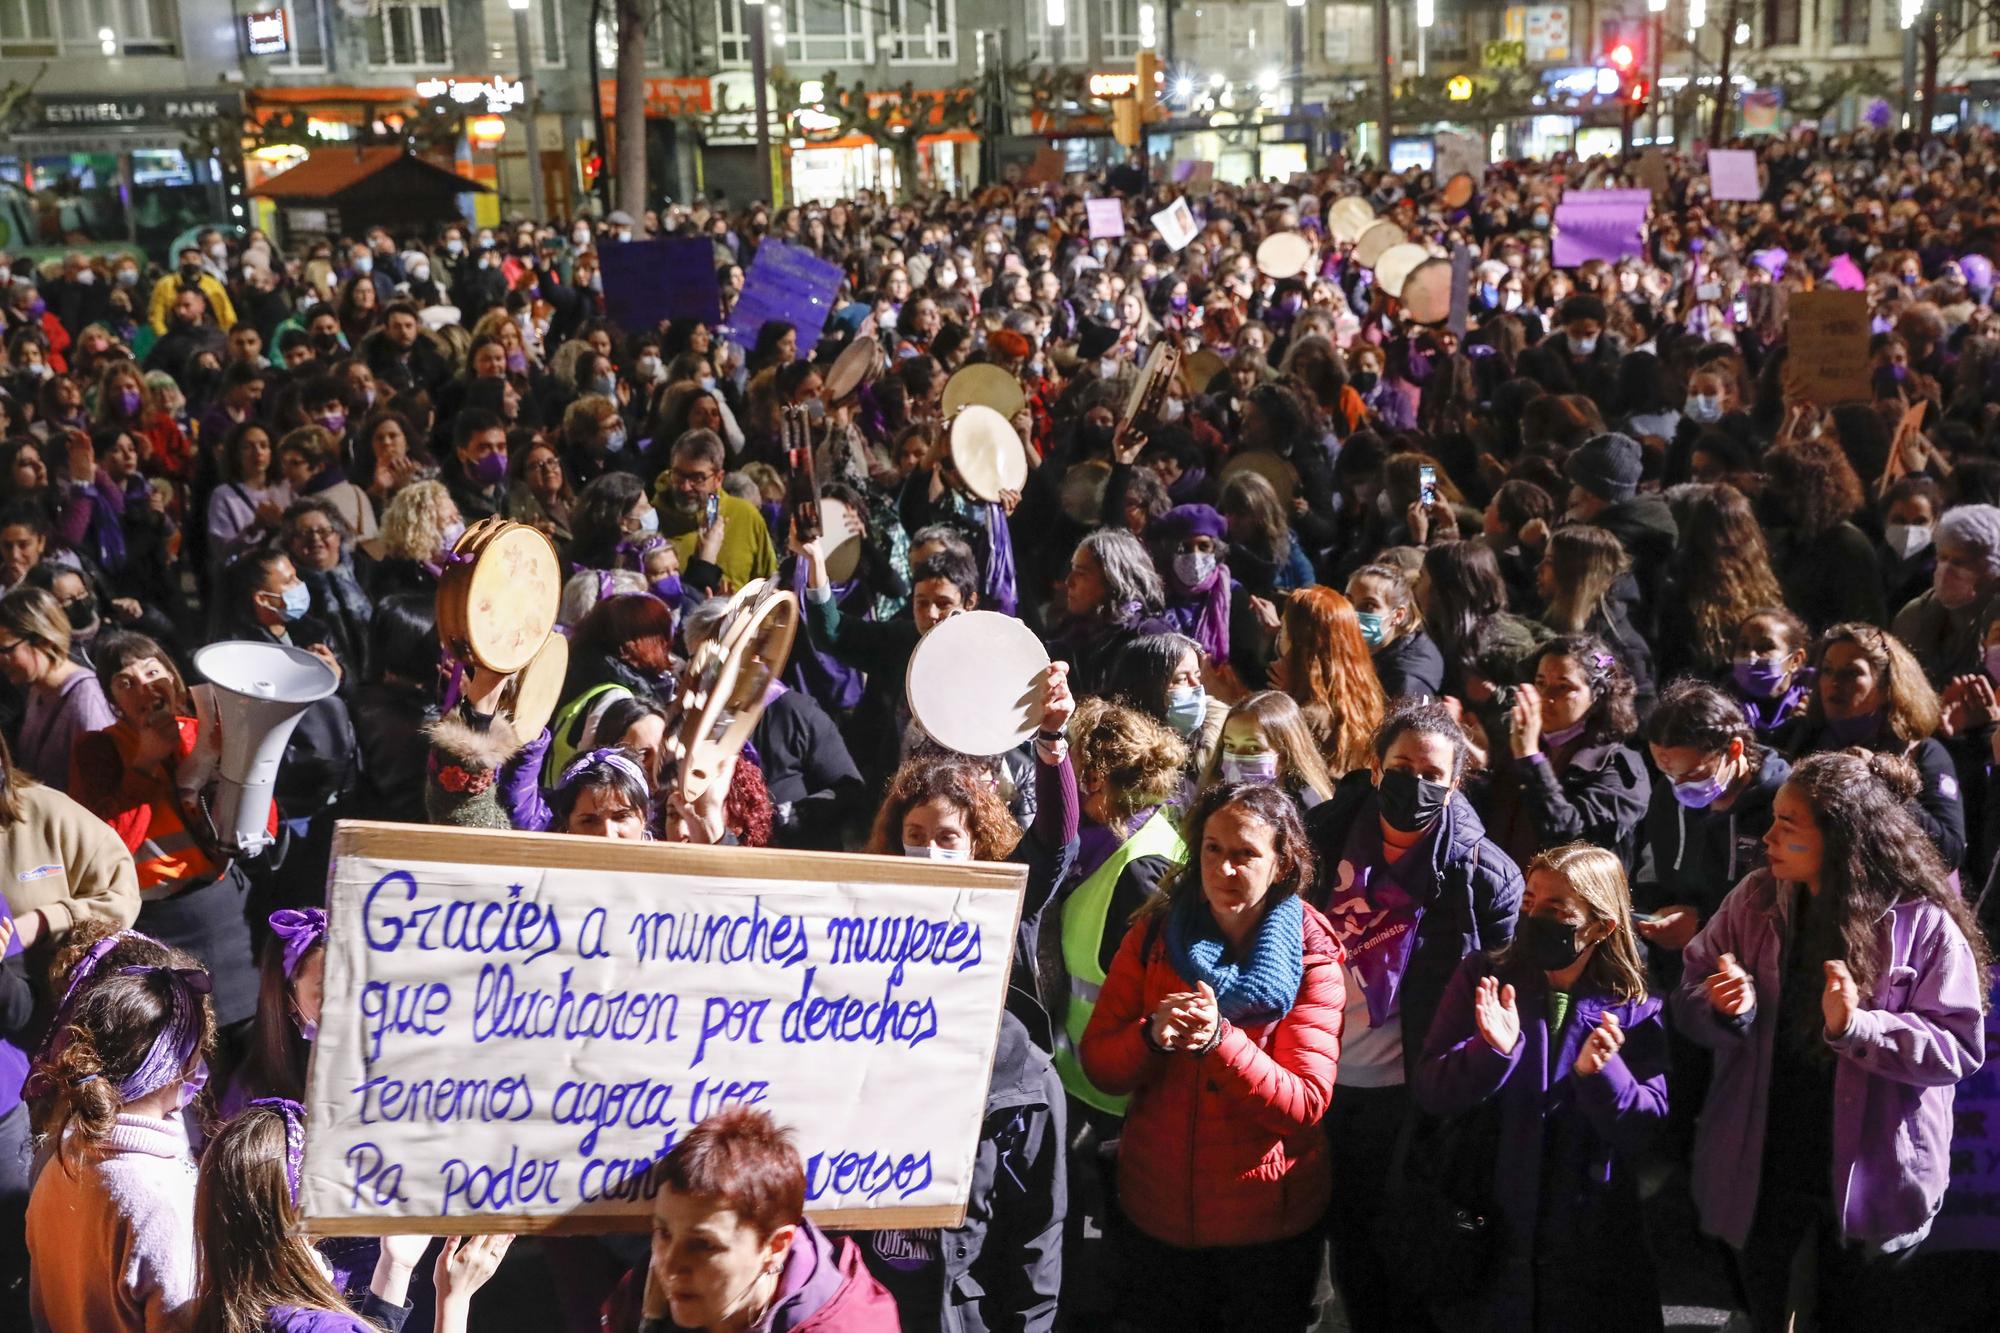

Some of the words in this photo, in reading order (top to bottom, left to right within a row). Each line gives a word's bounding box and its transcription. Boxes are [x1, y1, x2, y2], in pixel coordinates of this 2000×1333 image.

[46, 102, 146, 121] ESTRELLA
[165, 101, 218, 118] PARK
[363, 870, 562, 965] Gracies
[578, 907, 609, 959] a
[629, 895, 809, 969] munches
[827, 915, 982, 986] muyeres
[361, 981, 452, 1061] que
[474, 962, 678, 1044] llucharon
[689, 998, 771, 1069] por
[781, 966, 938, 1049] derechos
[351, 1074, 533, 1124] tenemos
[552, 1078, 676, 1156] agora
[346, 1142, 408, 1209] Pa
[439, 1145, 560, 1216] poder
[579, 1128, 679, 1204] cant
[803, 1150, 932, 1201] versos
